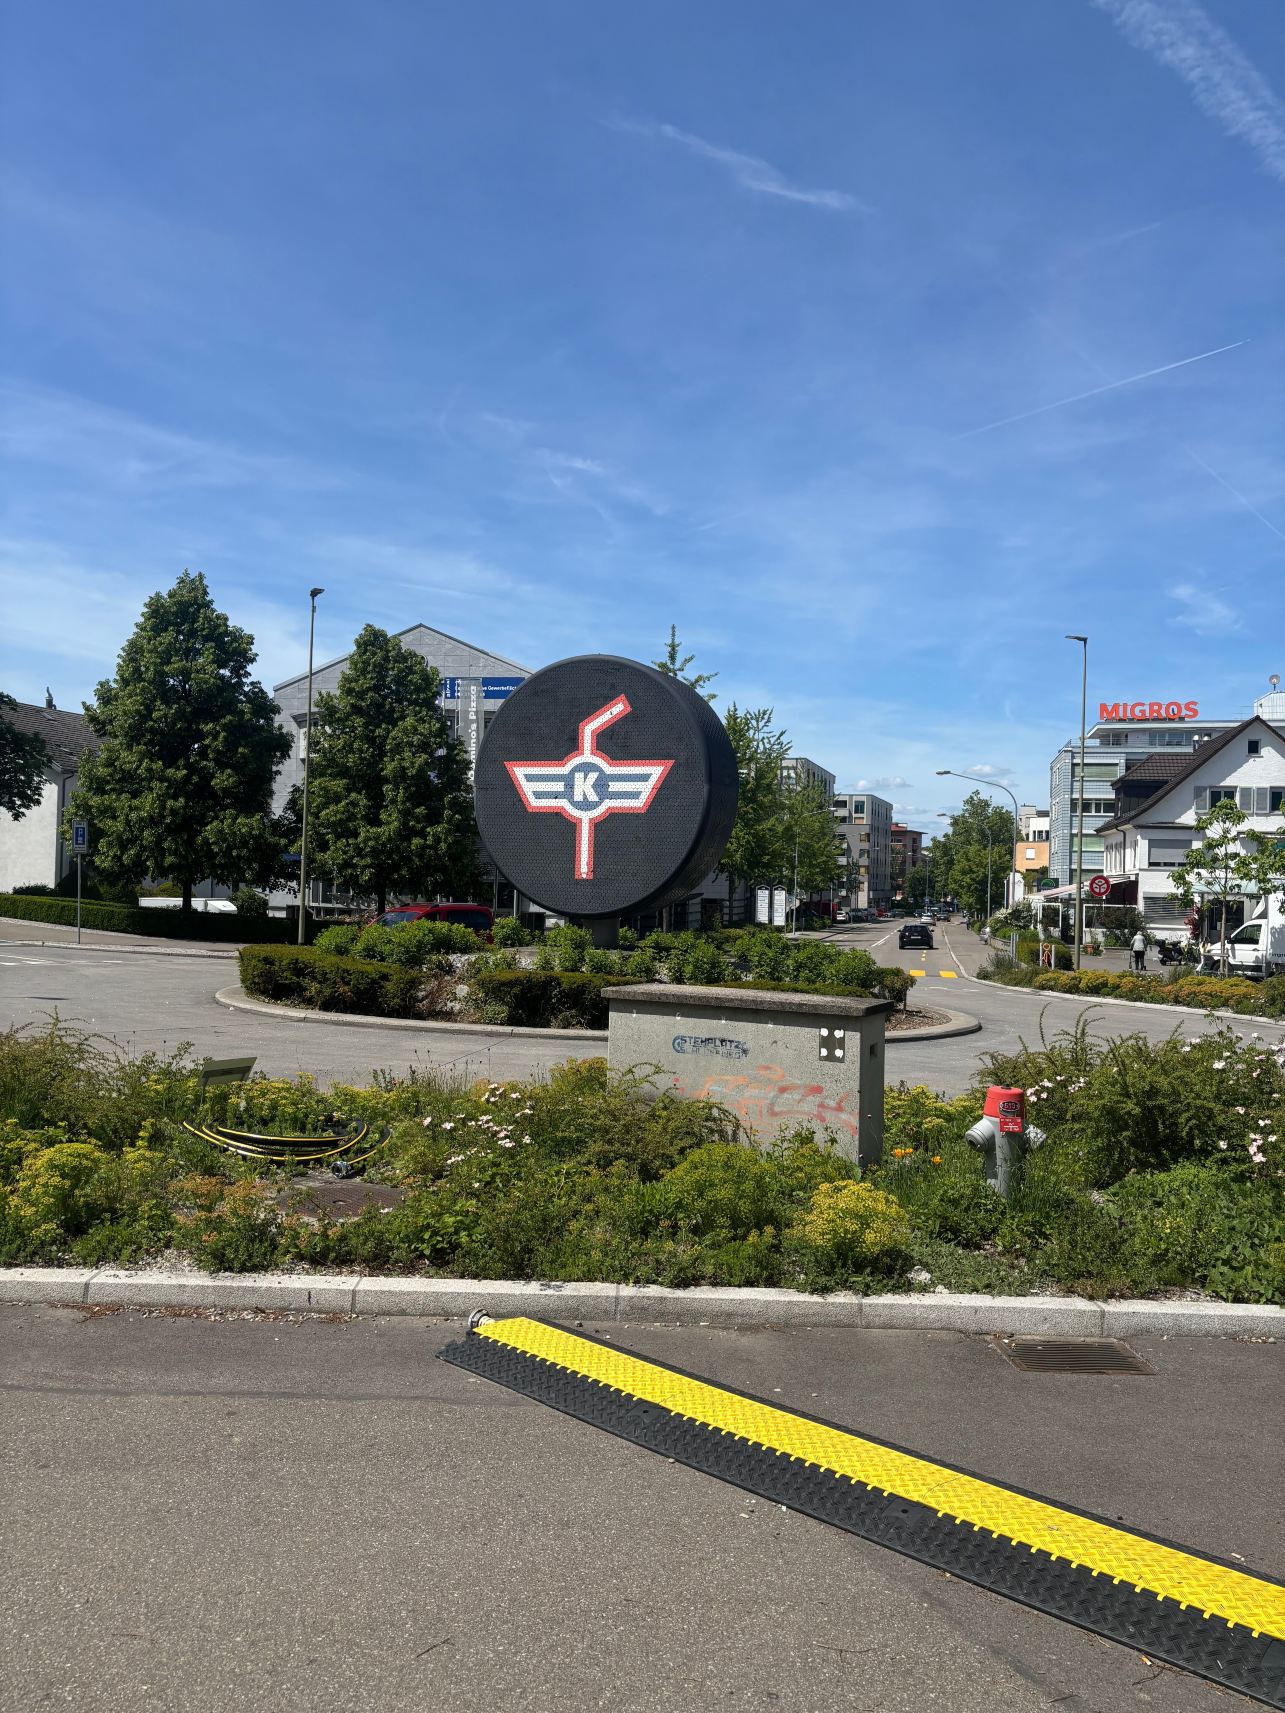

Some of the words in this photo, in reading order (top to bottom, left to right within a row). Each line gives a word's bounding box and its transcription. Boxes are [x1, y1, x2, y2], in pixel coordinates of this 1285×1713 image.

[468, 685, 477, 720] Pizza
[1099, 701, 1199, 721] MIGROS
[574, 772, 600, 801] K
